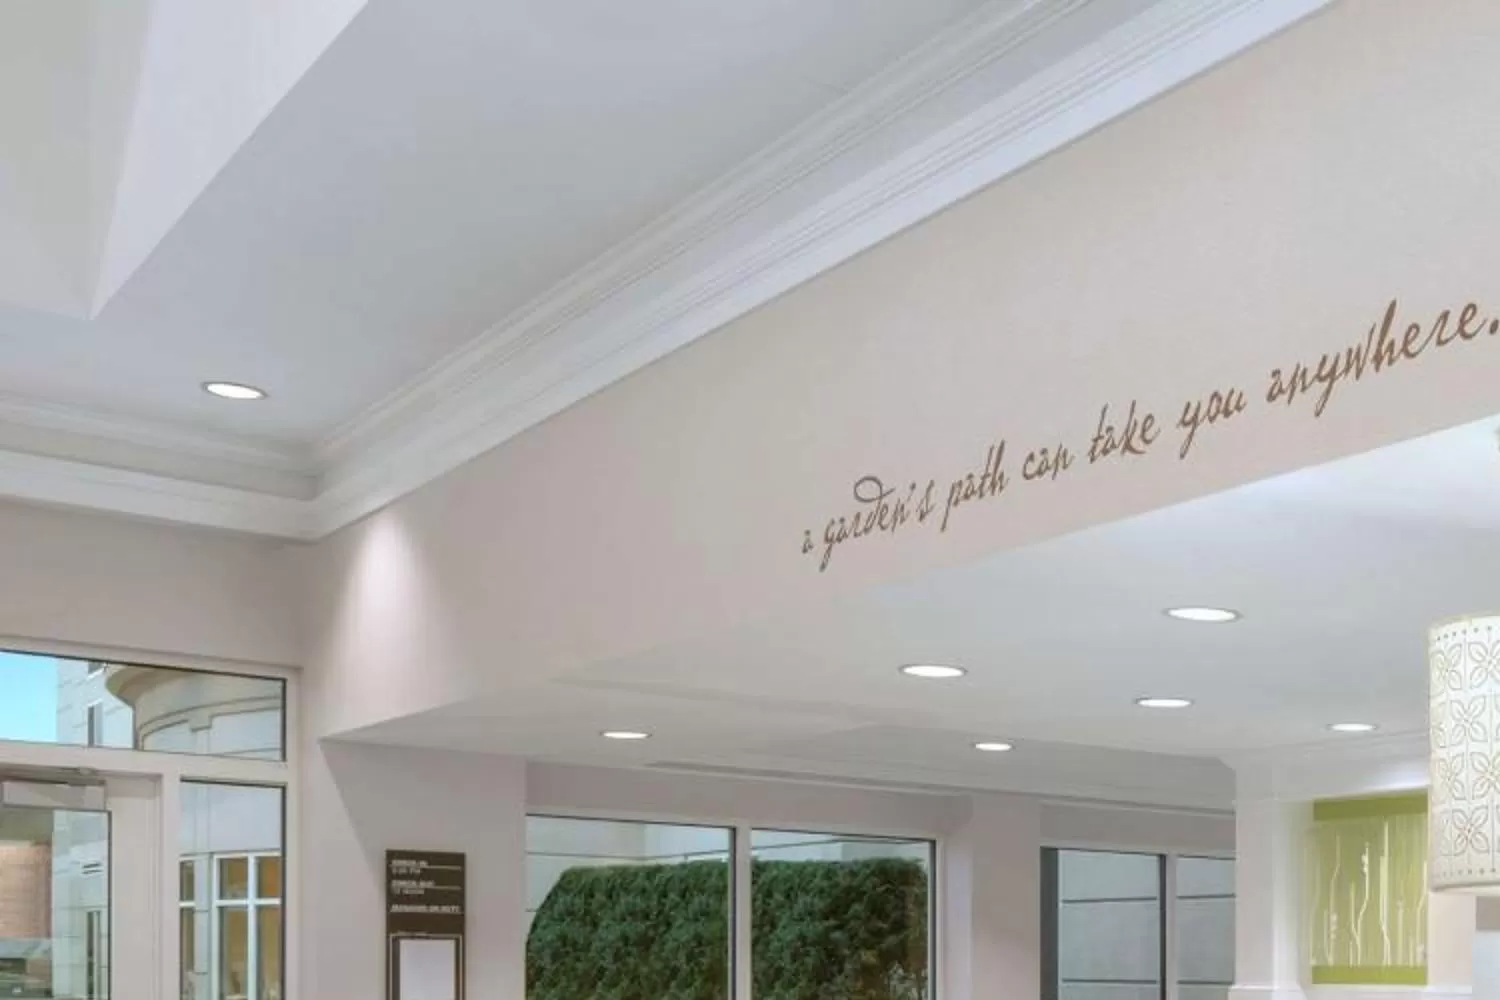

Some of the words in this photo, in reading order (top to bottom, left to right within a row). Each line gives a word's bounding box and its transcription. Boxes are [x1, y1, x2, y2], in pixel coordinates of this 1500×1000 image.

[801, 529, 814, 555] a
[819, 476, 936, 573] garden's
[939, 440, 1011, 533] path
[1022, 443, 1075, 481] can
[1087, 400, 1161, 465] take
[1176, 387, 1247, 461] you
